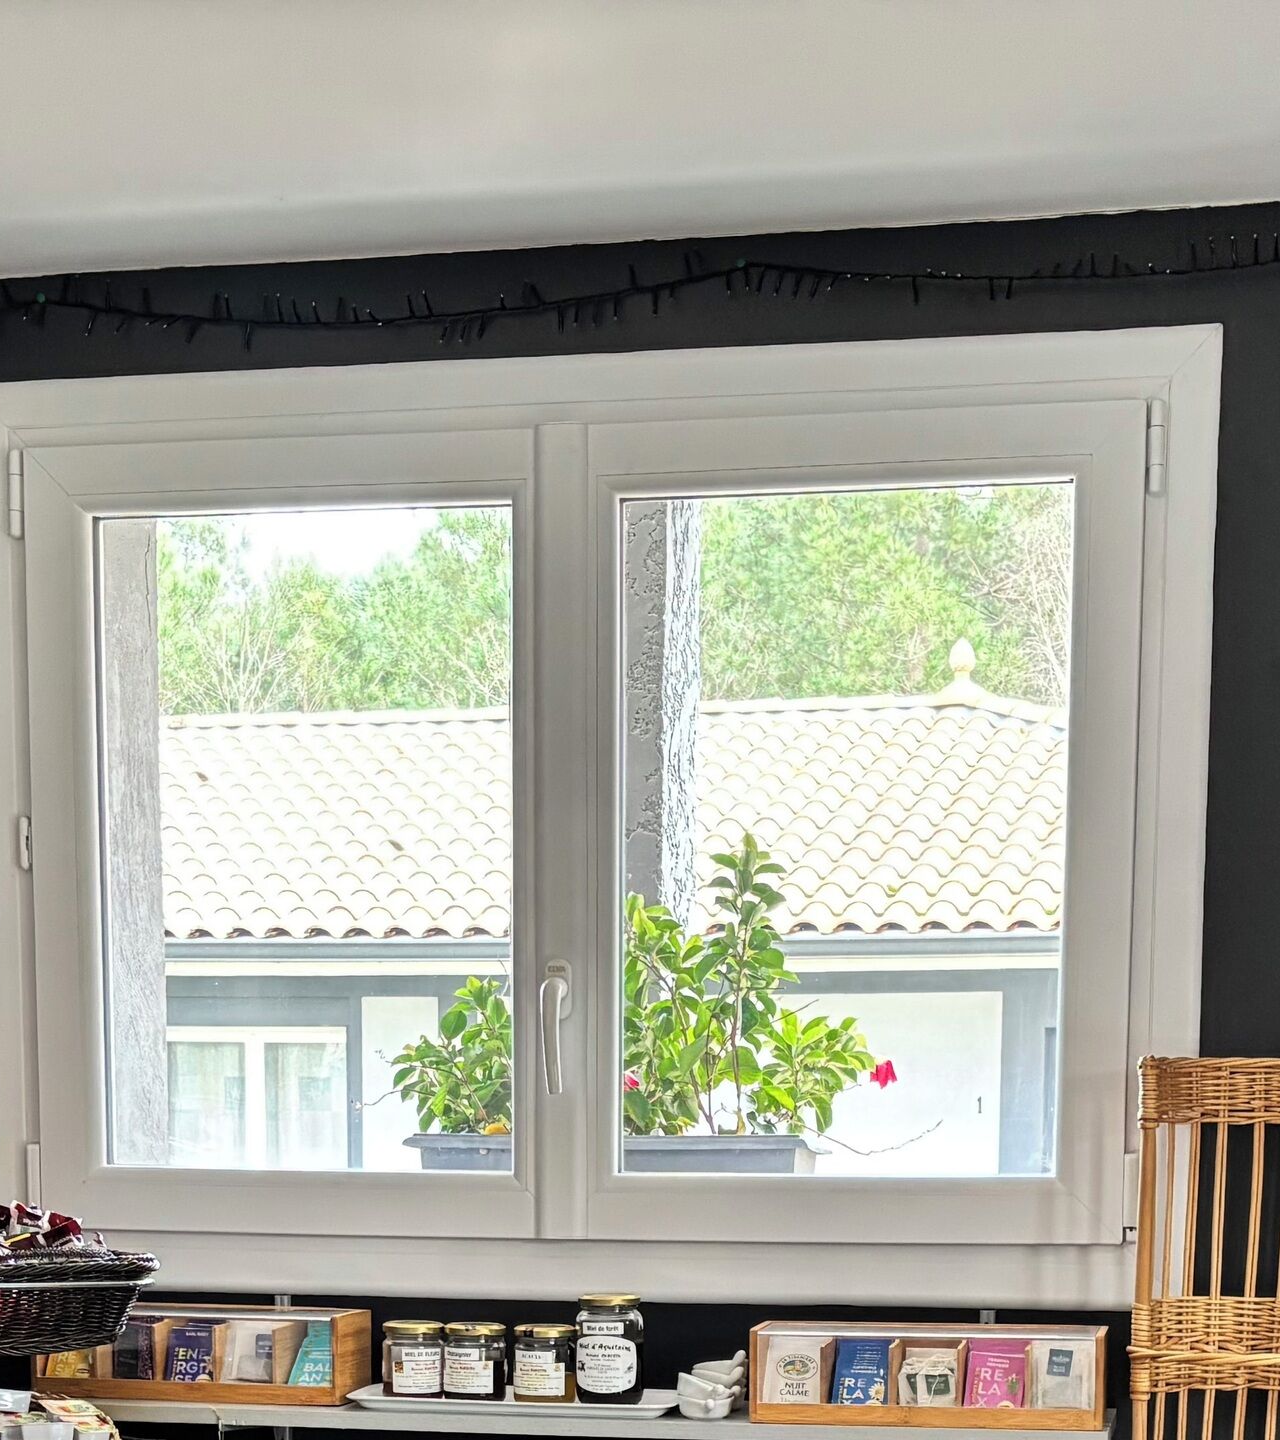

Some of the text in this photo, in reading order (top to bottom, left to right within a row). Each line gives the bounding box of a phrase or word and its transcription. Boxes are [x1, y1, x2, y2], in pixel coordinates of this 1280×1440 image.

[980, 1368, 1005, 1382] RE
[844, 1377, 867, 1387] RE
[779, 1388, 810, 1397] CALME
[977, 1381, 1001, 1395] LA
[842, 1389, 865, 1399] LA
